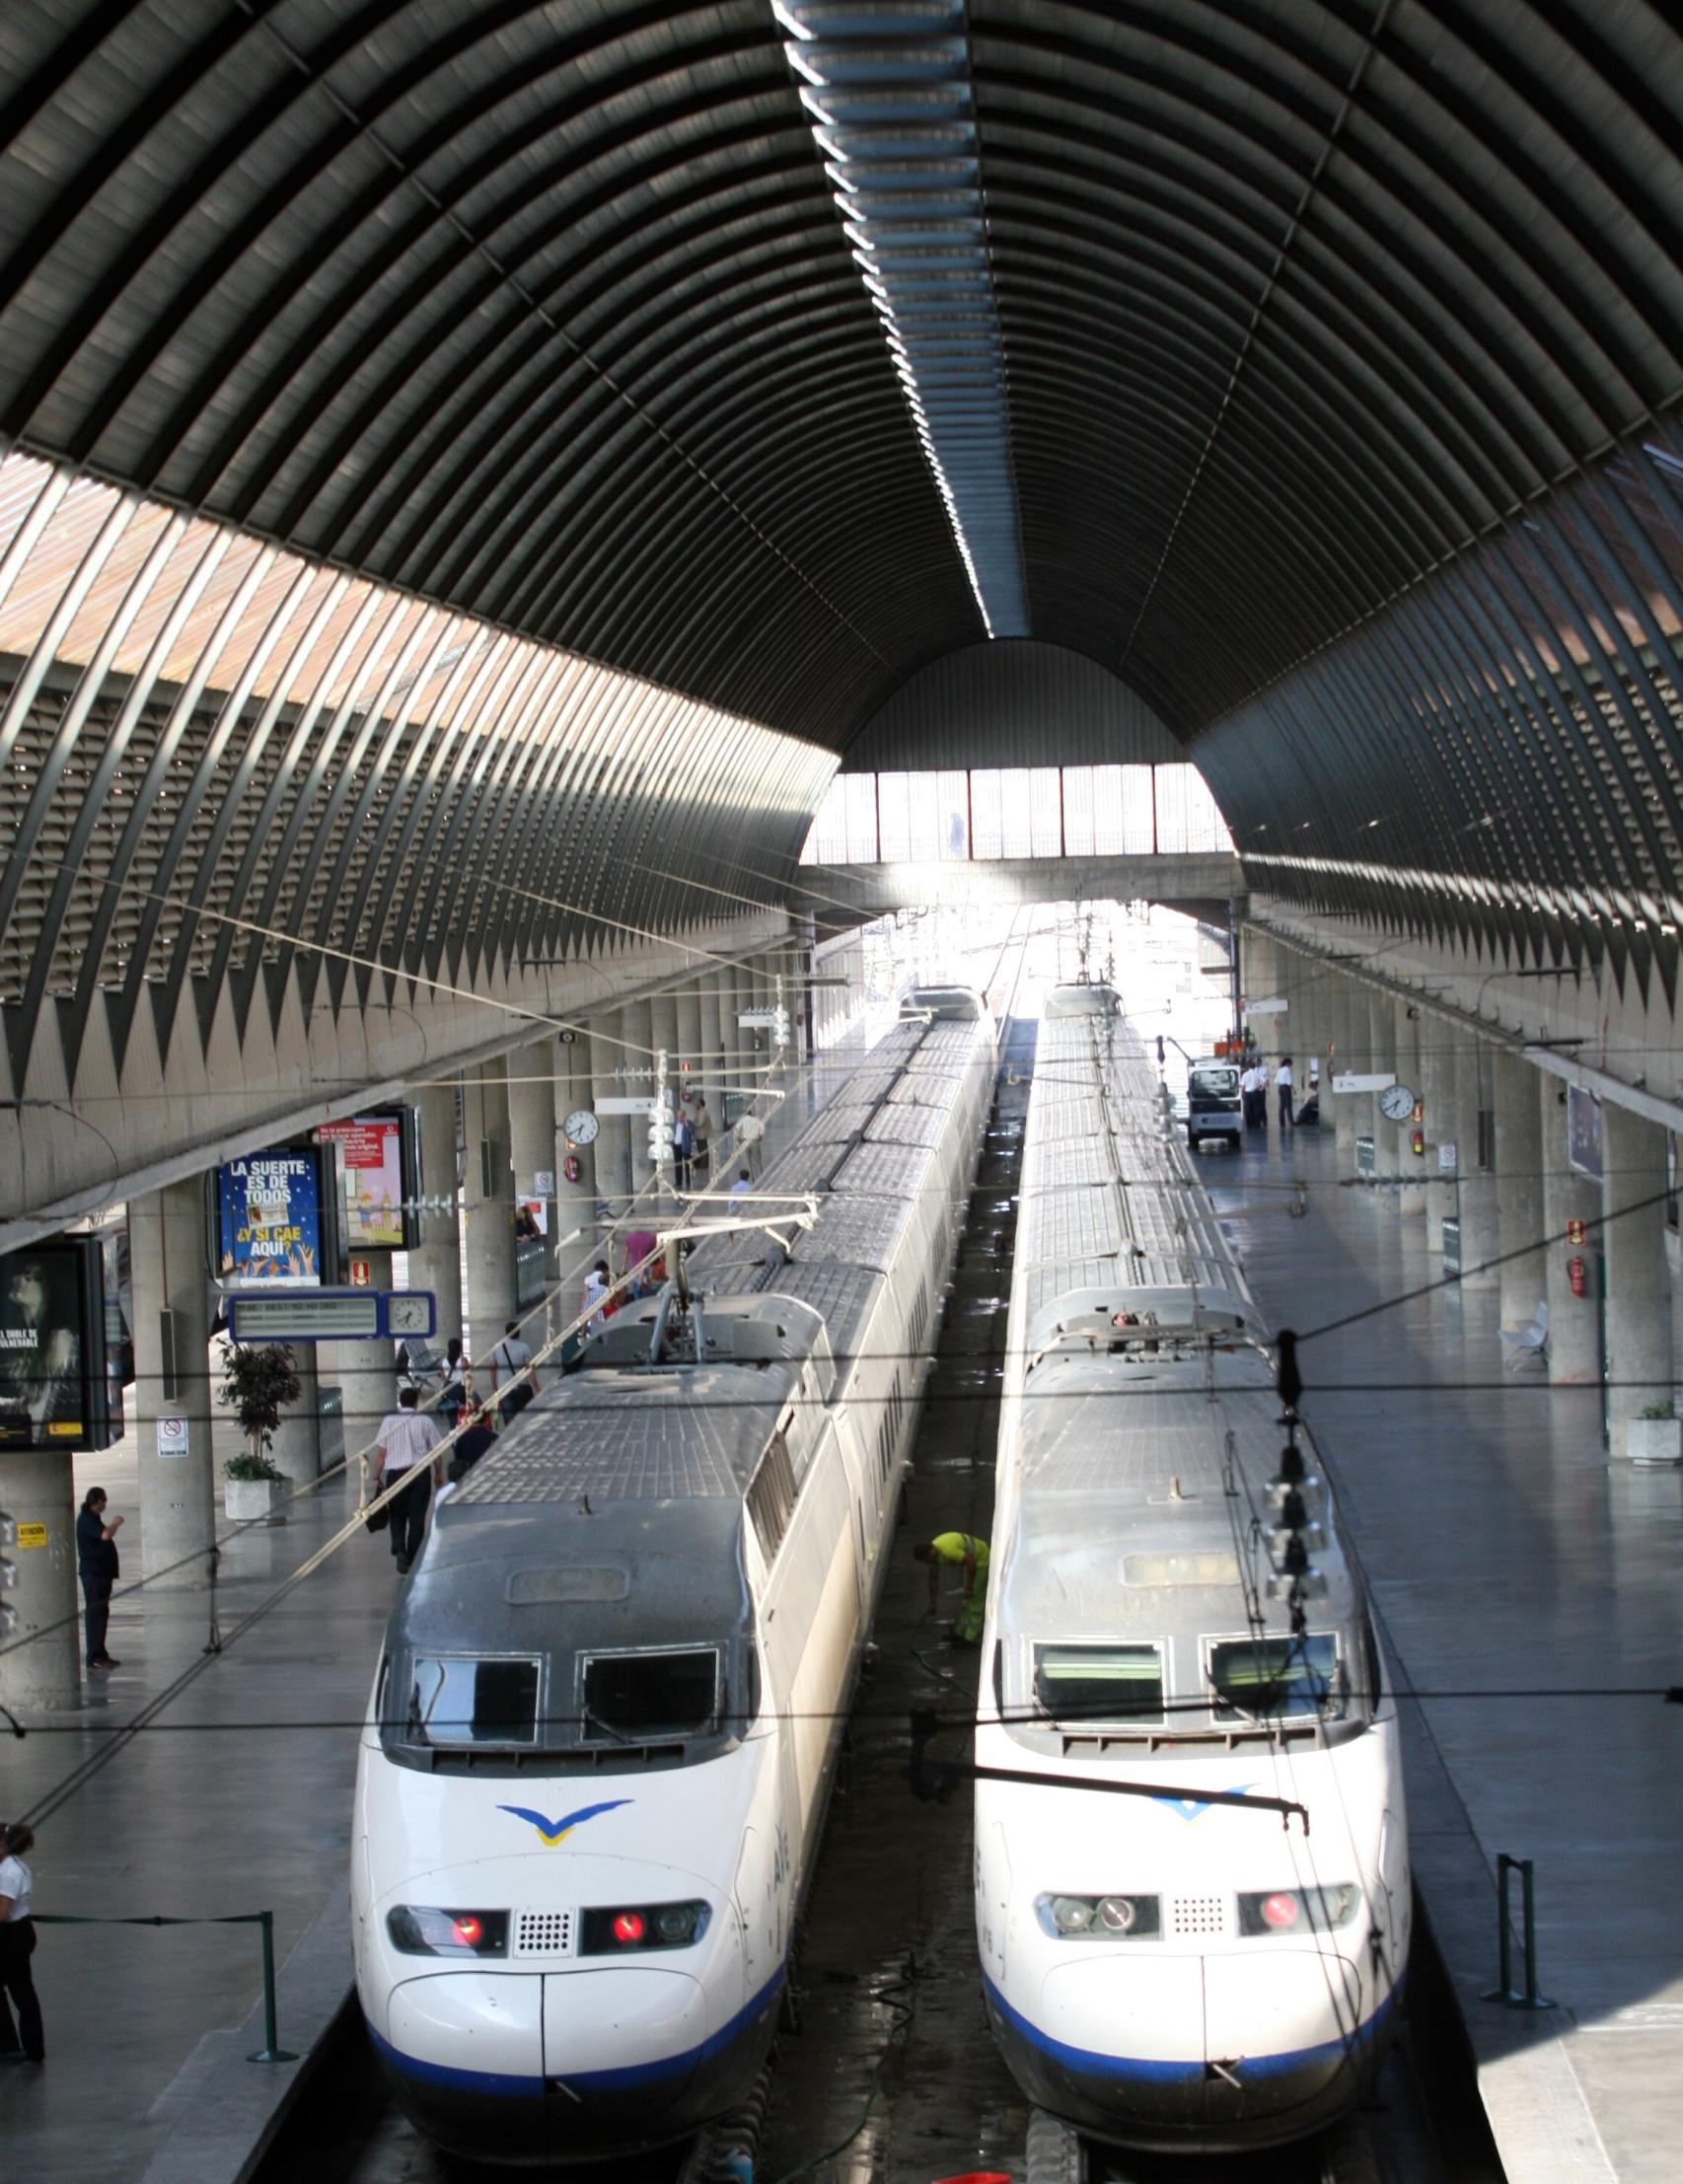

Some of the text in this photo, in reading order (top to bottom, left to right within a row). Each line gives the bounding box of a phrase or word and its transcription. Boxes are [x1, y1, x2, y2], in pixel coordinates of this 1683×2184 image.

[231, 1160, 306, 1176] LA SUERTE
[247, 1175, 288, 1190] ES DE
[244, 1189, 291, 1203] TODOS
[237, 1226, 301, 1242] ¿Y SI CAE
